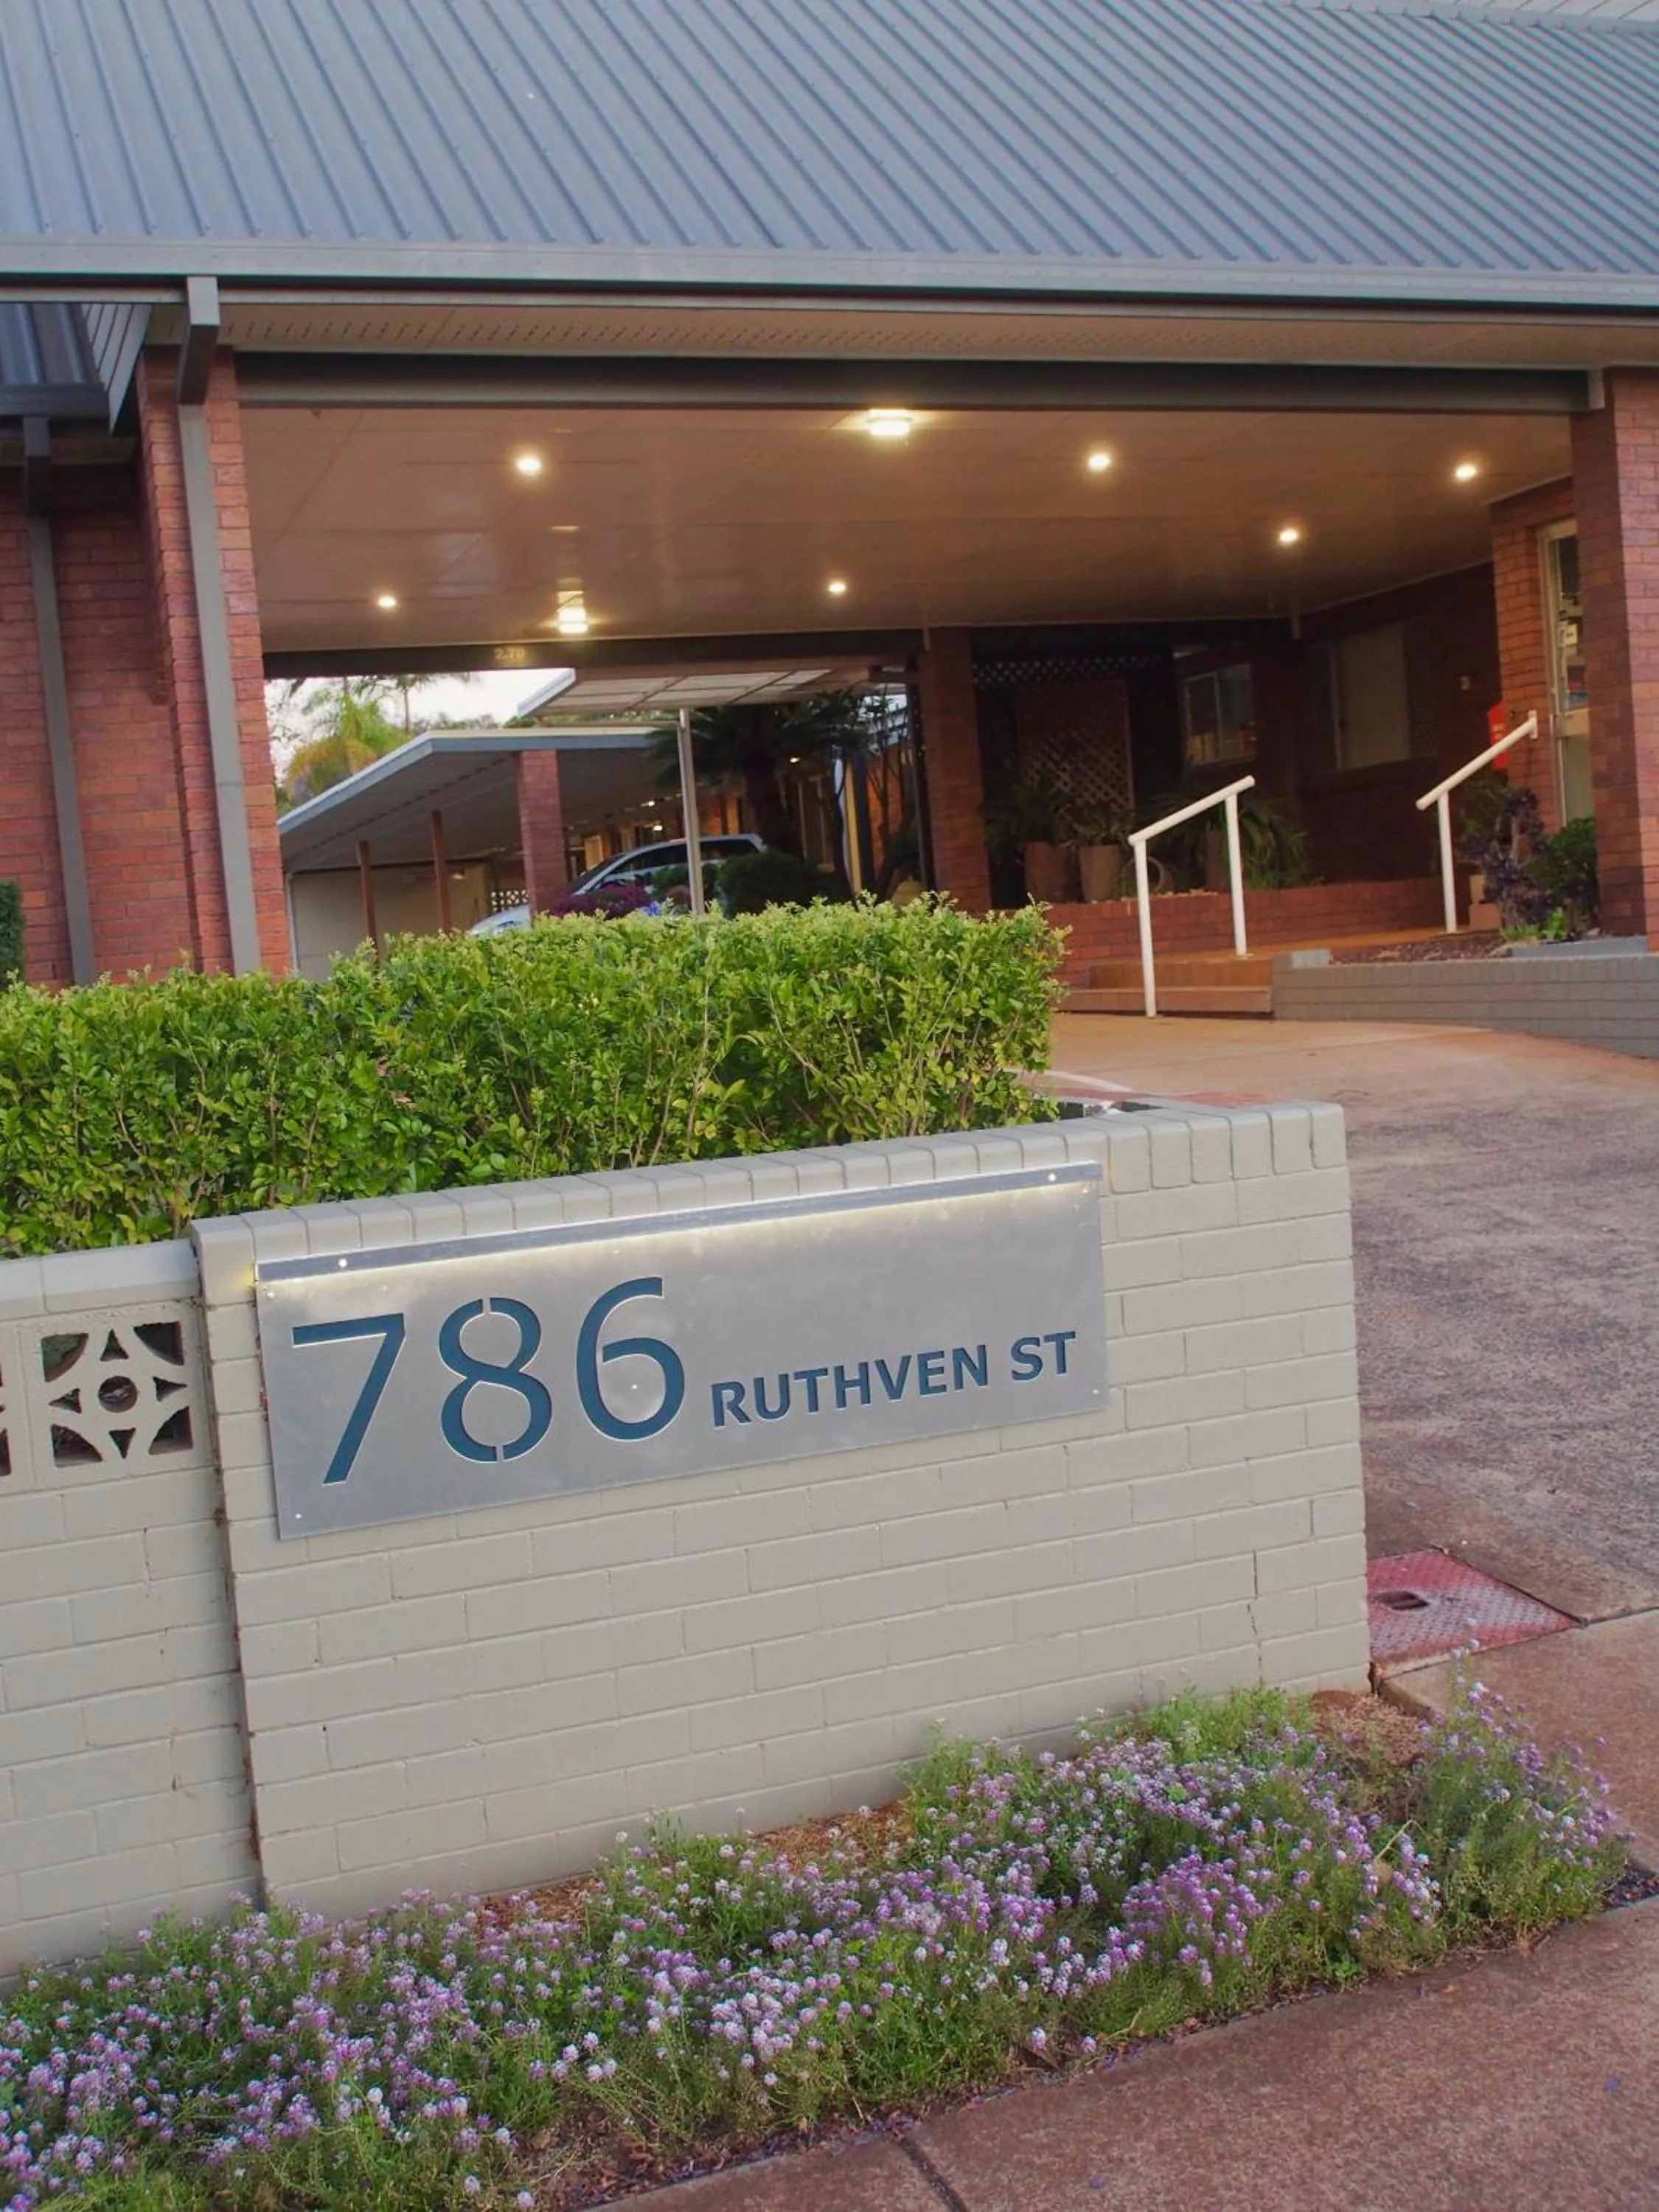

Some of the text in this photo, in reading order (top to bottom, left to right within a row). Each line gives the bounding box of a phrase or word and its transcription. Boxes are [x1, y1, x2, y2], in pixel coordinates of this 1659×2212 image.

[293, 1277, 1076, 1485] 786 RUTHVEN ST
